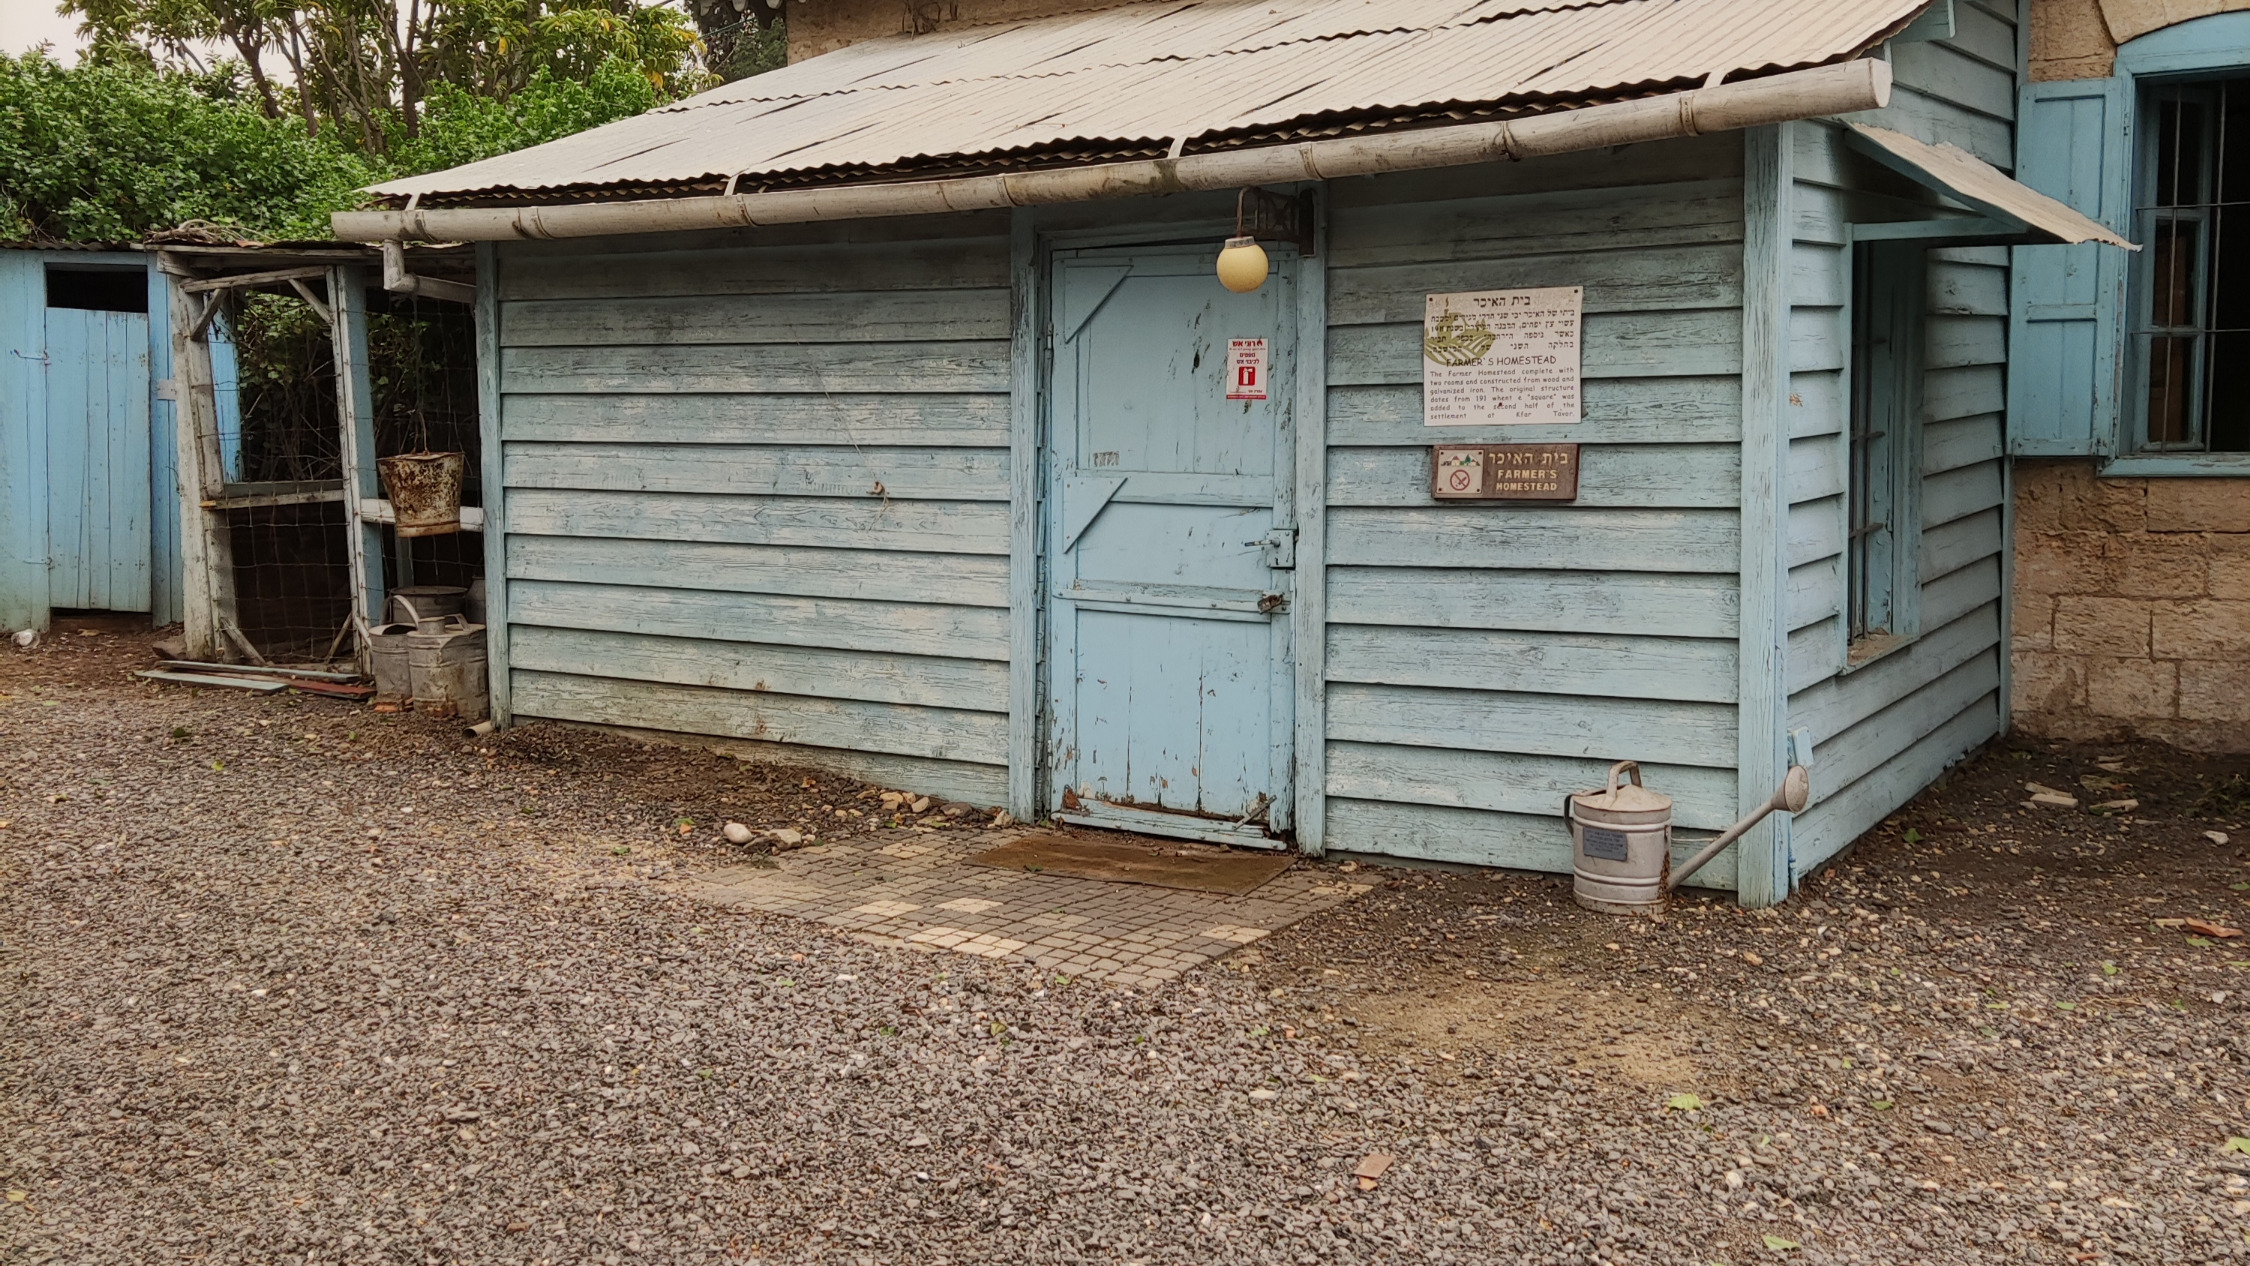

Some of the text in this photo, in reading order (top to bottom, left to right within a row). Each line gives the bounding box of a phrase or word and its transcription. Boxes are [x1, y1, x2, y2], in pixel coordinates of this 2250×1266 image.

[1474, 296, 1530, 308] בית האיכר
[1497, 356, 1556, 365] HOMESTEAD
[1430, 388, 1464, 396] galvanized
[1489, 453, 1568, 466] בית האיכר
[1498, 470, 1557, 479] FARMER'S
[1496, 482, 1557, 491] HOMESTEAD
